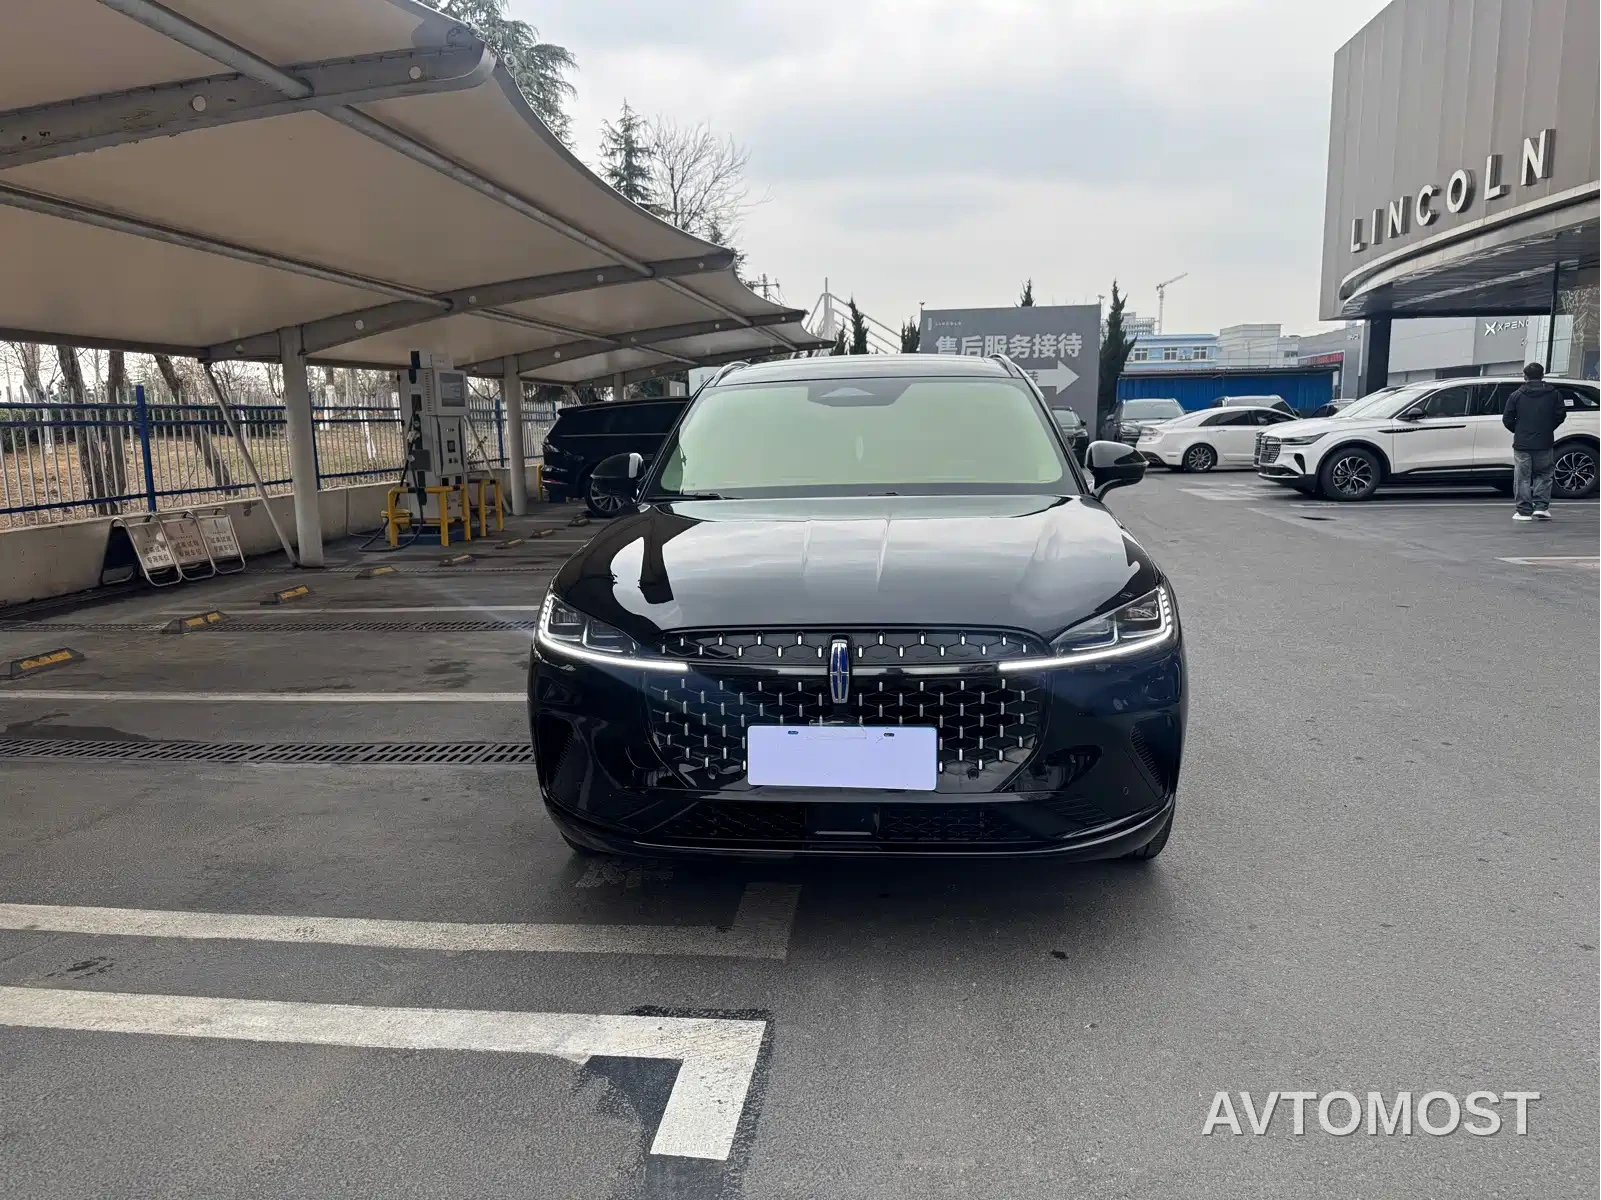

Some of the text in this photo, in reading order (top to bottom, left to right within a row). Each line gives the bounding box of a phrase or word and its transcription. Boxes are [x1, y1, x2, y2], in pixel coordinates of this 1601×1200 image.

[1350, 128, 1557, 254] LINCOLN
[935, 332, 1083, 359] 售后服务接待
